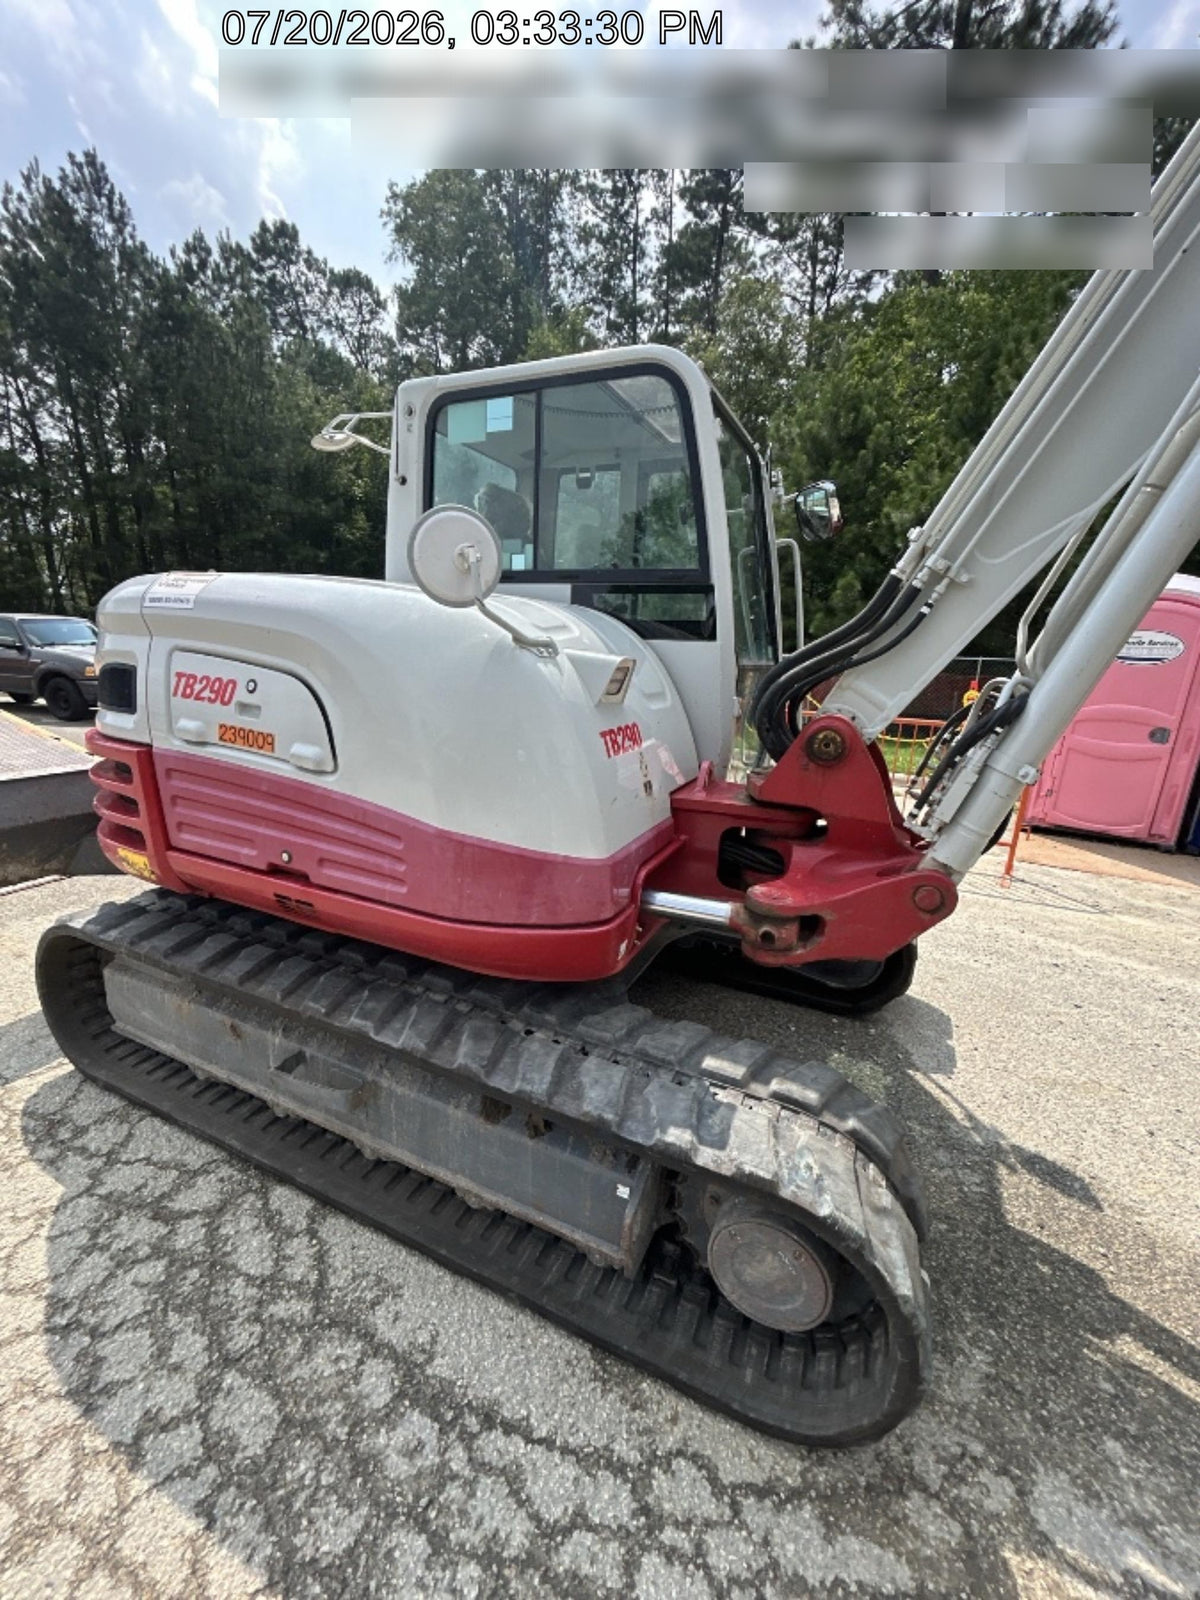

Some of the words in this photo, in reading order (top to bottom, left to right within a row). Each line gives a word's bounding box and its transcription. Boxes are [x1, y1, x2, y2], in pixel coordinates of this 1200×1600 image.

[172, 671, 237, 706] TB290
[218, 722, 275, 753] 239009
[599, 721, 642, 759] TB290
